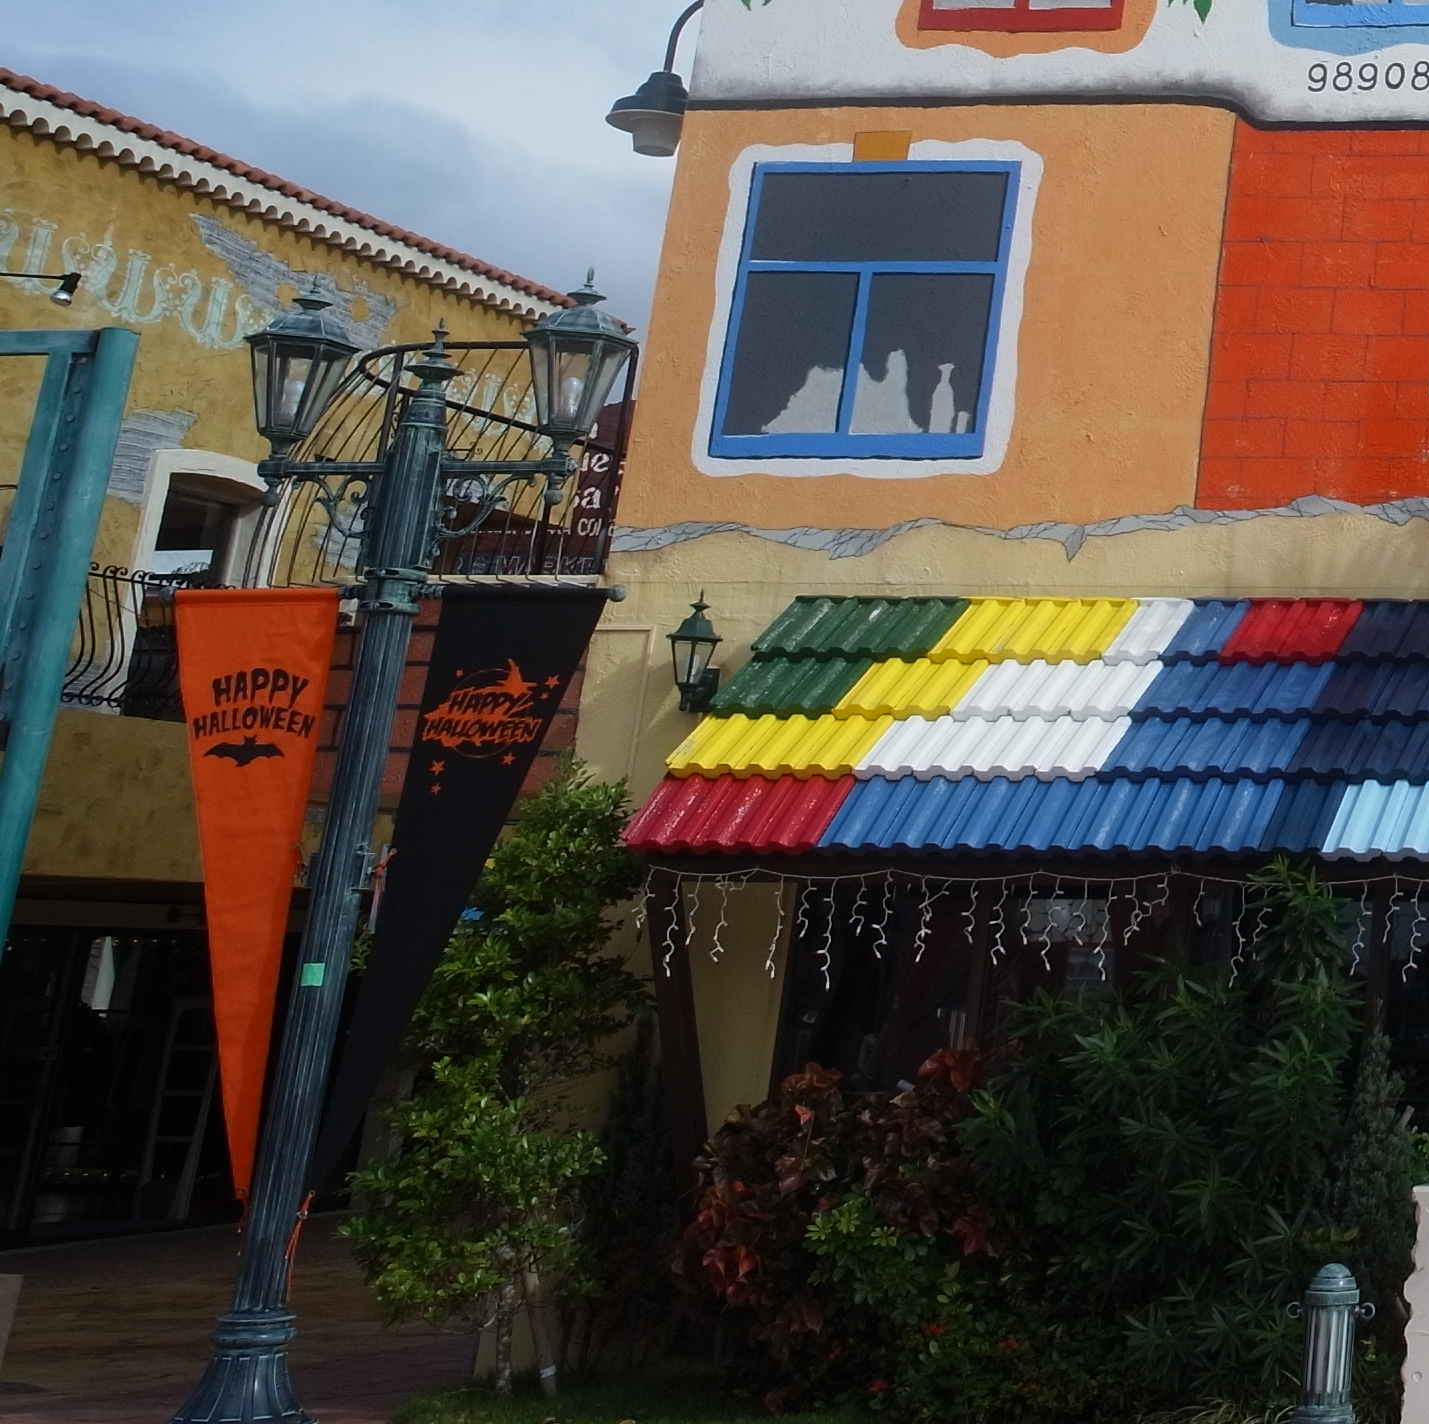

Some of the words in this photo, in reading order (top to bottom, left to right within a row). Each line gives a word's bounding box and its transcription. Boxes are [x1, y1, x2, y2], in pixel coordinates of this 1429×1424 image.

[212, 668, 310, 709] HAPPY
[450, 690, 532, 716] HAPPY
[193, 705, 315, 739] HALLOWEEN
[424, 719, 541, 742] HALLOWEEN
